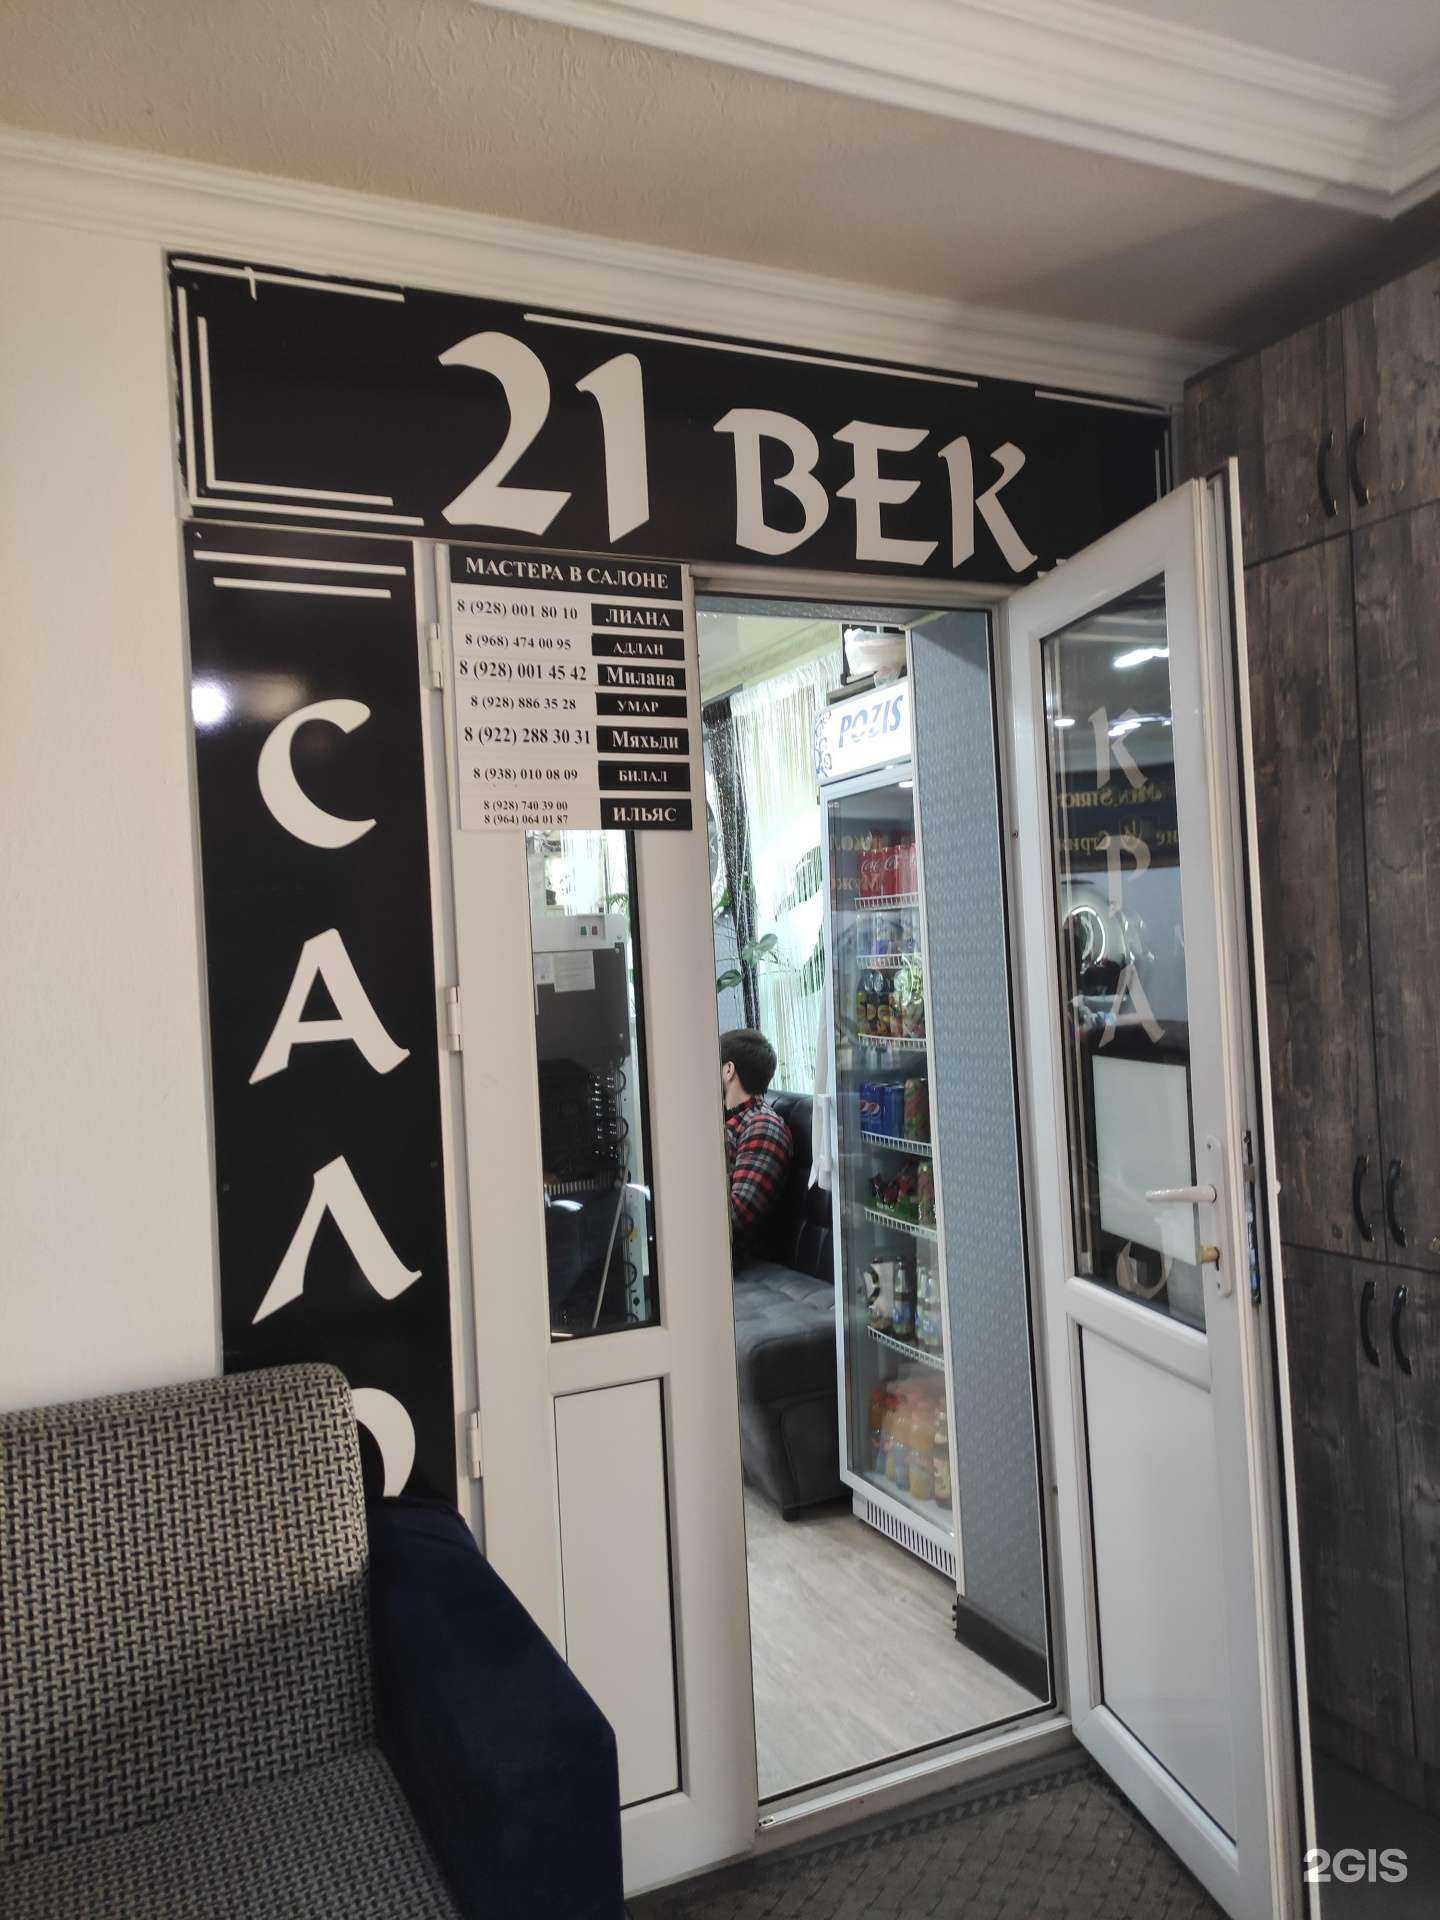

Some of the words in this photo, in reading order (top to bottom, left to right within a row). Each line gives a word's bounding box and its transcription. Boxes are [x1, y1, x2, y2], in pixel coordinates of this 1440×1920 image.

[438, 331, 650, 544] 21
[713, 408, 1038, 574] ВЕК
[466, 556, 564, 581] МАСТЕРА
[570, 567, 582, 582] В
[587, 568, 668, 589] САЛОНЕ
[457, 599, 465, 612] 8
[470, 600, 506, 616] (928)
[512, 603, 535, 617] 001
[541, 604, 557, 619] 80
[563, 607, 578, 620] 10
[605, 608, 670, 627] ЛИАНА
[465, 633, 473, 645] 8
[477, 634, 508, 648] (968)
[513, 636, 534, 649] 474
[538, 638, 553, 649] 00
[556, 639, 571, 650] 95
[613, 642, 664, 656] АДЛАН
[459, 660, 468, 675] 8
[473, 661, 512, 681] (928)
[517, 663, 541, 679] 001
[549, 665, 565, 680] 45
[571, 667, 587, 681] 42
[606, 666, 675, 688] Милана
[471, 695, 478, 707] 8
[482, 696, 514, 710] (928)
[518, 697, 540, 709] 886
[544, 698, 558, 709] 35
[562, 699, 576, 710] 28
[617, 700, 659, 713] УМАР
[464, 726, 473, 741] 8
[478, 727, 517, 745] (922)
[522, 728, 548, 743] 288
[553, 728, 570, 743] 30
[575, 729, 590, 744] 31
[612, 730, 679, 750] Мяхьди
[473, 768, 480, 779] 8
[485, 768, 517, 782] (938)
[521, 769, 542, 780] 010
[546, 769, 560, 780] 08
[564, 769, 578, 780] 09
[618, 769, 668, 783] БИЛАЛ
[493, 801, 519, 812] (928)
[521, 801, 539, 810] 740
[543, 801, 553, 810] 39
[556, 801, 568, 811] 00
[613, 807, 677, 823] ИЛЬЯС
